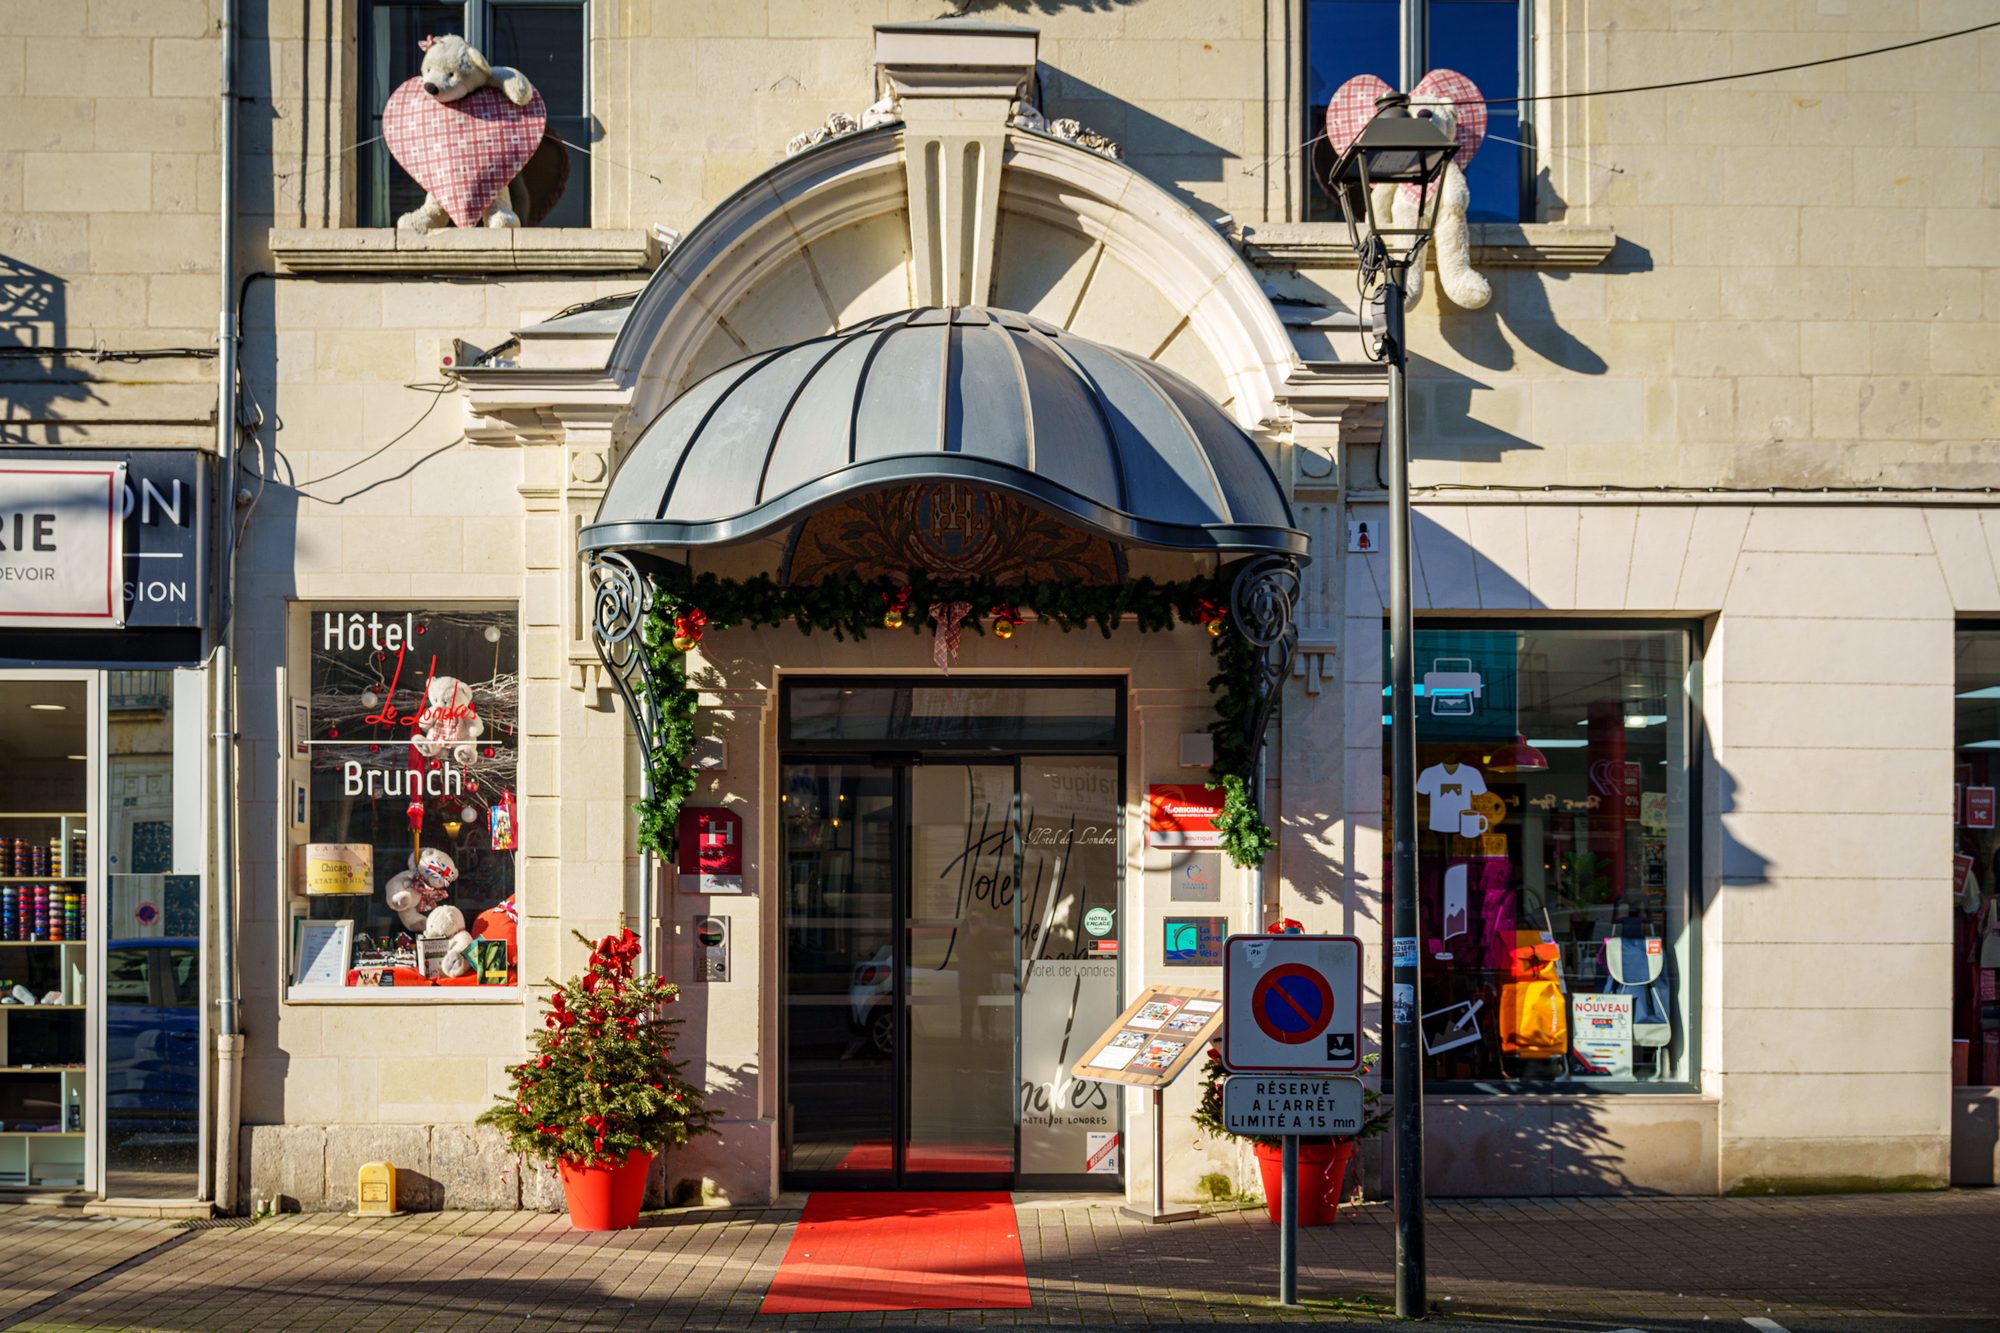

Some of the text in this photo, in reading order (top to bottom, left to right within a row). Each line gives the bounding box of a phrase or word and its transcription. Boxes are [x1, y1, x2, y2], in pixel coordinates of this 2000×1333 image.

[0, 513, 57, 552] IE
[324, 612, 414, 651] Hôtel
[364, 641, 478, 726] Le Londres
[344, 760, 462, 796] Brunch
[706, 821, 735, 845] H
[1074, 827, 1117, 845] Londres
[321, 863, 352, 874] Chicago
[1059, 965, 1072, 977] de
[1575, 1003, 1630, 1013] NOUVEAU
[1256, 1081, 1331, 1095] RÉSERVÉ
[1252, 1100, 1261, 1111] A
[1054, 1116, 1063, 1124] DE
[1068, 1116, 1108, 1125] LONDRES
[1231, 1113, 1356, 1128] LIMITÉ A 15 min
[1108, 1158, 1115, 1167] R
